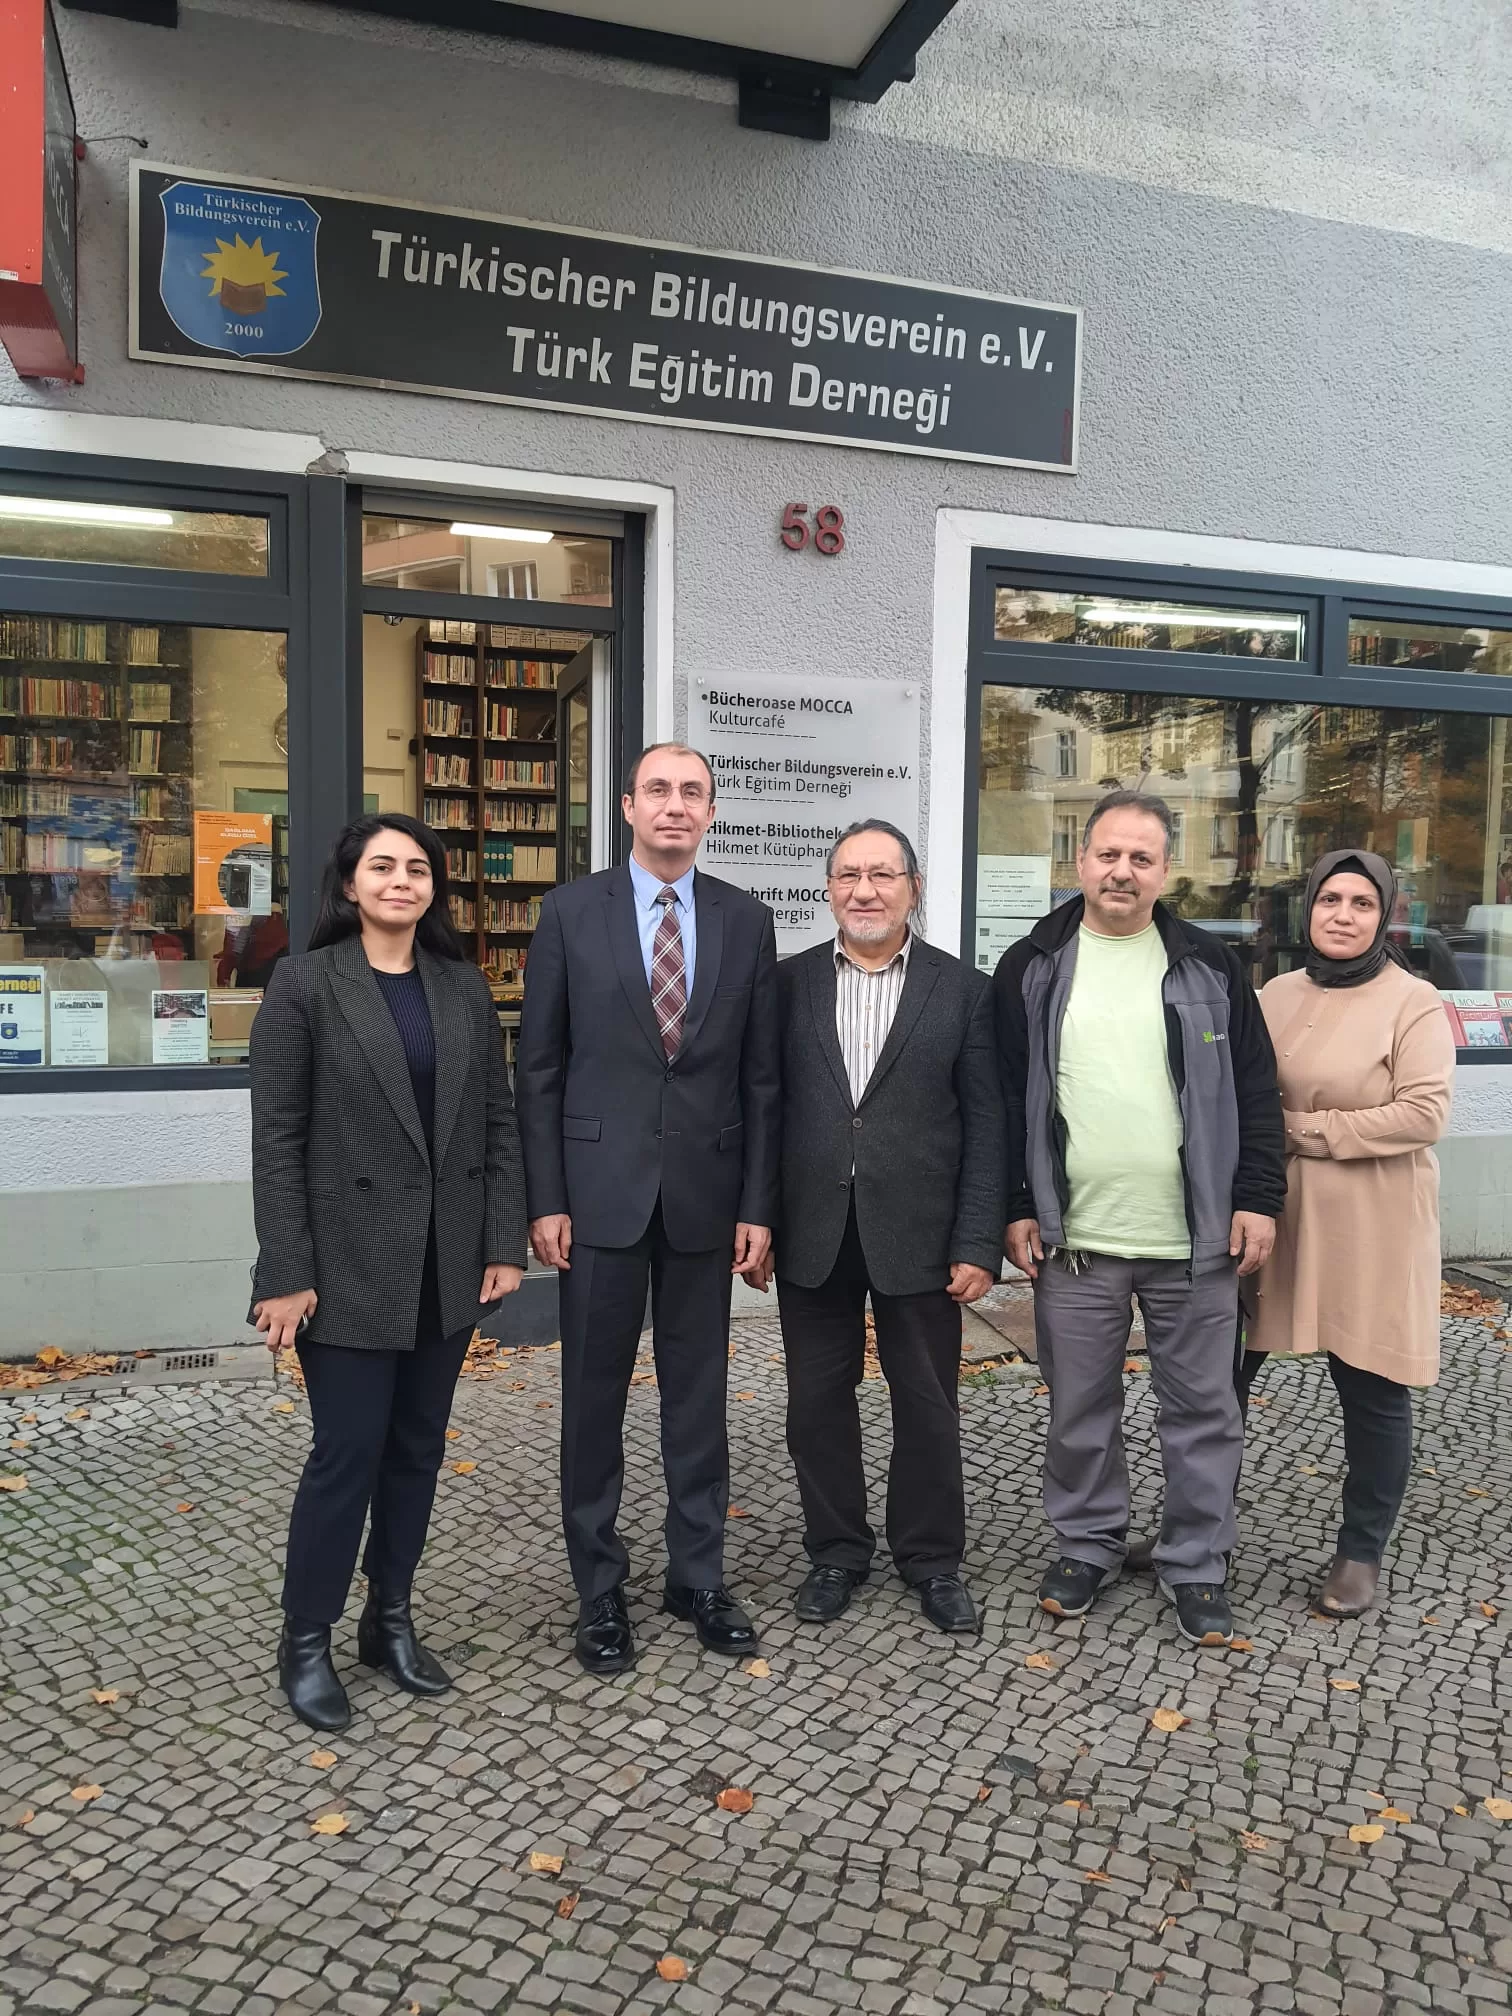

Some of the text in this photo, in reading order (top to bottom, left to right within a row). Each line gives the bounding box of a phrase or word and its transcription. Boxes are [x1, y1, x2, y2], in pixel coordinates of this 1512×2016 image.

[203, 193, 283, 216] Türkischer
[175, 202, 311, 233] Bildungsverein e.V.
[371, 229, 1053, 373] Türkischer Bildungsverein e.V.
[224, 322, 264, 339] 2000
[506, 326, 952, 434] Türk Eğitim Derneği
[781, 503, 845, 555] 58
[709, 690, 853, 714] Bücheroase MOCCA
[709, 710, 786, 729] Kulturcafé
[708, 754, 912, 780] Türkischer Bildungsverein e.V.
[713, 774, 852, 798] ürk Eğitim Derneği
[706, 839, 760, 855] Hikmet
[745, 886, 784, 901] hrift
[773, 906, 815, 924] ergisi
